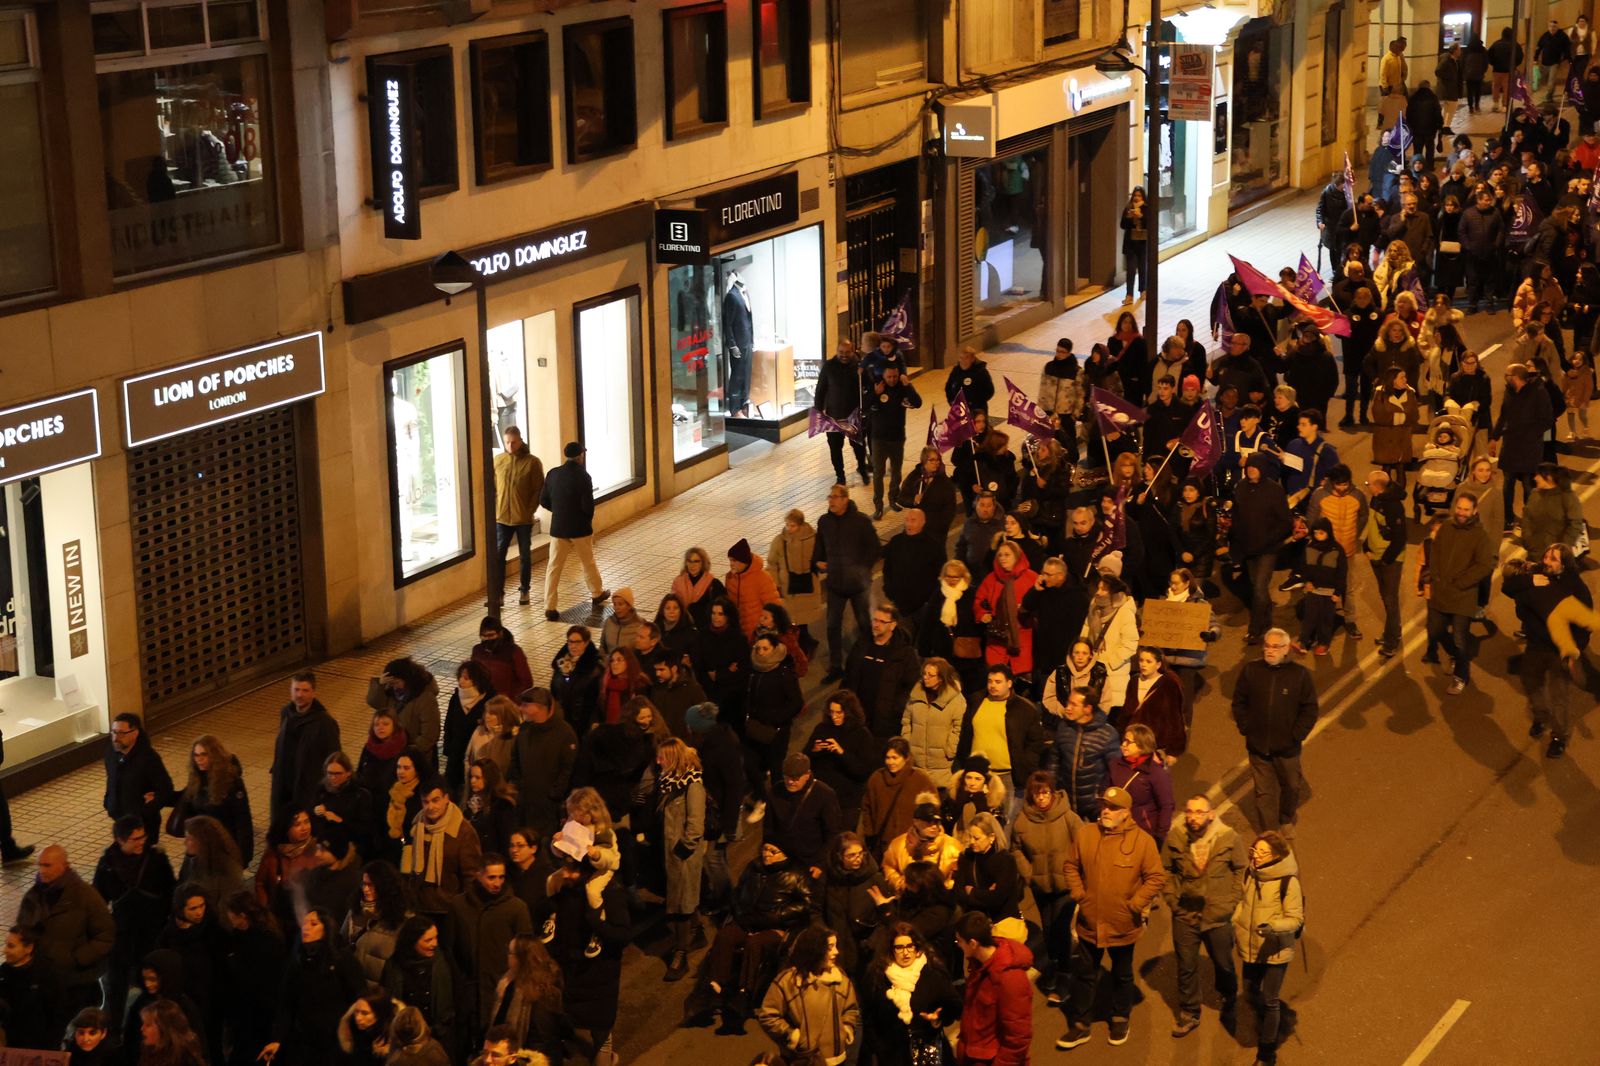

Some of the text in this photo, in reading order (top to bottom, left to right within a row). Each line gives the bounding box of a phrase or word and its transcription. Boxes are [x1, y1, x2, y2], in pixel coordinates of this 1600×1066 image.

[387, 79, 406, 224] ADOLFO DOMINGUEZ
[721, 192, 782, 226] FLORENTINO
[515, 230, 587, 267] DOMINGUEZ
[659, 243, 700, 253] FLORENTINO
[154, 353, 295, 407] LION OF PORCHES
[208, 390, 247, 411] LONDON
[65, 545, 84, 626] NEW IN
